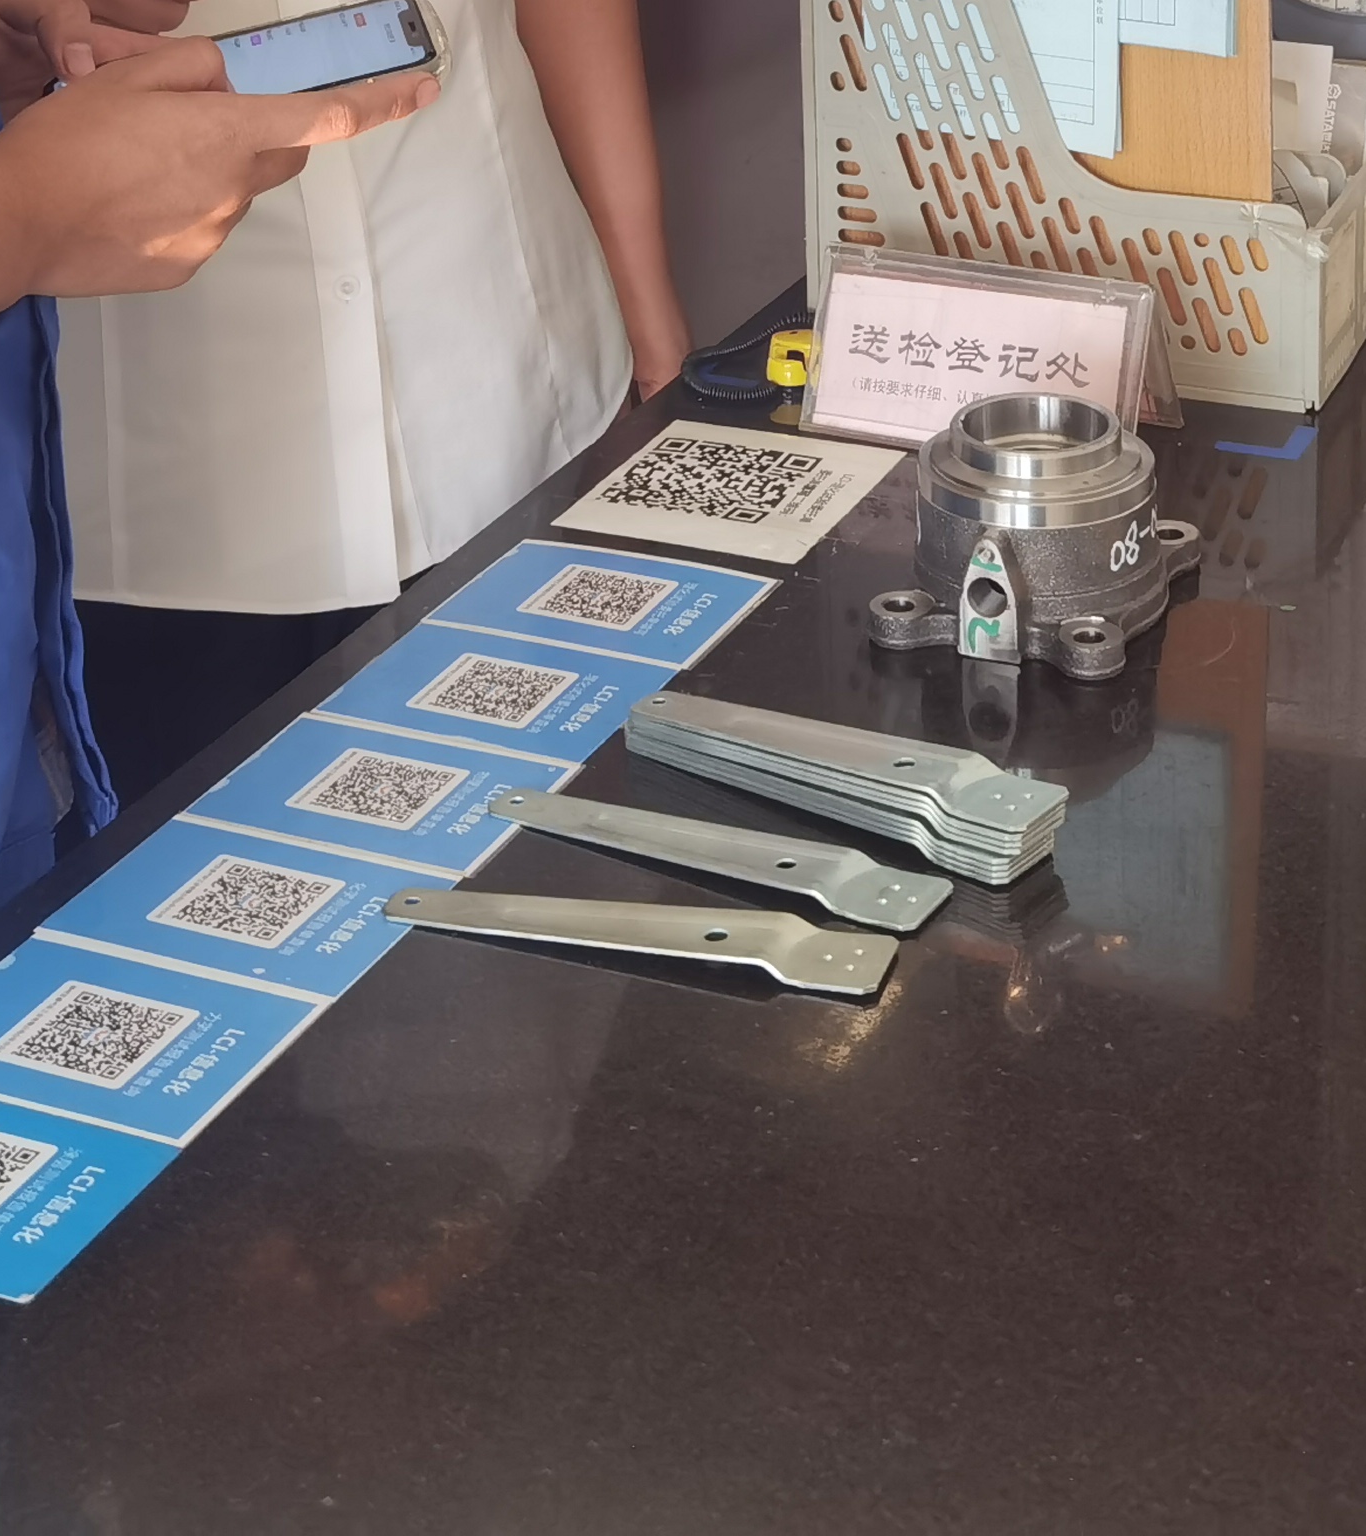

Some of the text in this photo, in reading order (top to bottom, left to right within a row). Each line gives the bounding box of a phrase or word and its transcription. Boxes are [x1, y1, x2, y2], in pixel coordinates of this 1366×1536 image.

[848, 323, 1091, 389] 送检登记处
[159, 1027, 250, 1096] LCI-信息化
[9, 1164, 110, 1246] LCI-信息化
